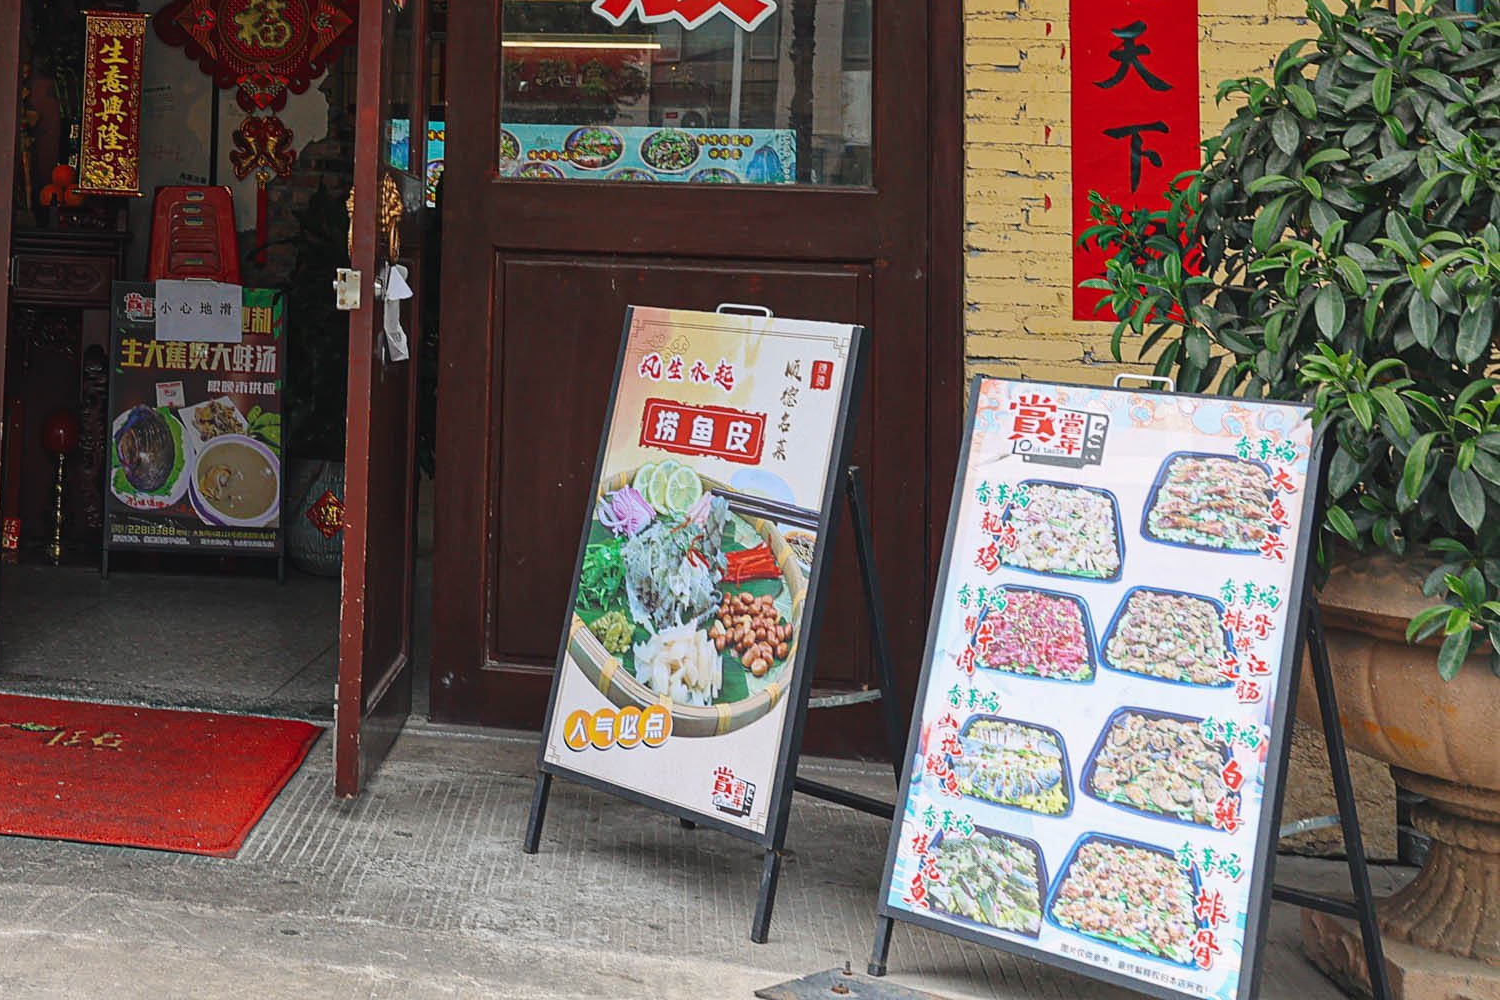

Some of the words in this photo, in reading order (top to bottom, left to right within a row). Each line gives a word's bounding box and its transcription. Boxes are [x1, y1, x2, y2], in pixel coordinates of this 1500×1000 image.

[95, 37, 129, 151] 生意興隆
[160, 301, 232, 316] 小心地滑
[639, 354, 736, 391] 风生水起
[654, 410, 753, 453] 捞鱼皮
[570, 714, 665, 743] 人气必点
[1190, 888, 1230, 970] 排骨
